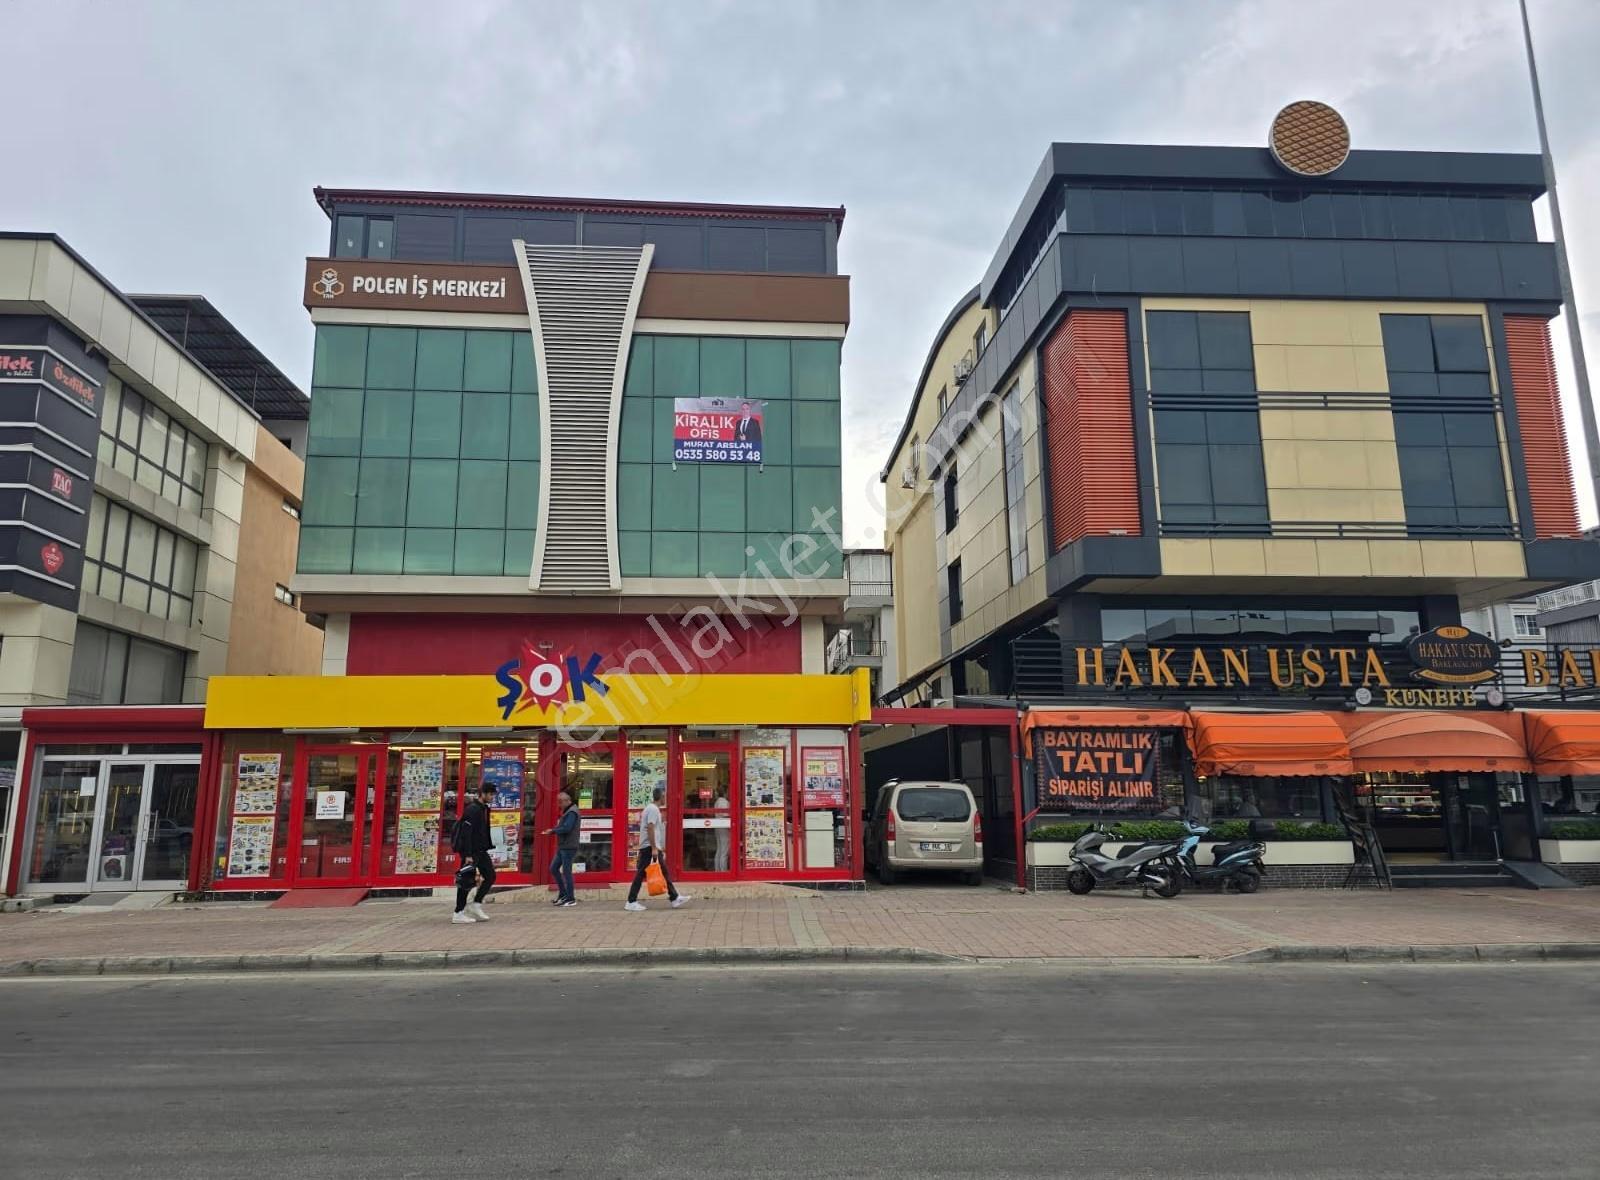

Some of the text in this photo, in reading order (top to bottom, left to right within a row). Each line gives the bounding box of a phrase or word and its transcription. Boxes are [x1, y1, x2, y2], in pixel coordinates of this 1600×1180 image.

[352, 275, 506, 299] POLEN İŞ MERKEZİ
[675, 414, 735, 429] KİRALIK
[690, 428, 720, 439] OFİS
[683, 440, 753, 449] MURAT ARSLAN
[675, 449, 761, 461] 0535 580 53 48
[1419, 643, 1492, 658] HAKAN USTA
[1075, 647, 1391, 688] HAKAN USTA
[495, 652, 610, 720] ŞOK
[1044, 731, 1152, 749] BAYRAMLIK
[1056, 750, 1143, 774] TATLI
[1049, 776, 1154, 800] SİPARİŞİ ALINIR
